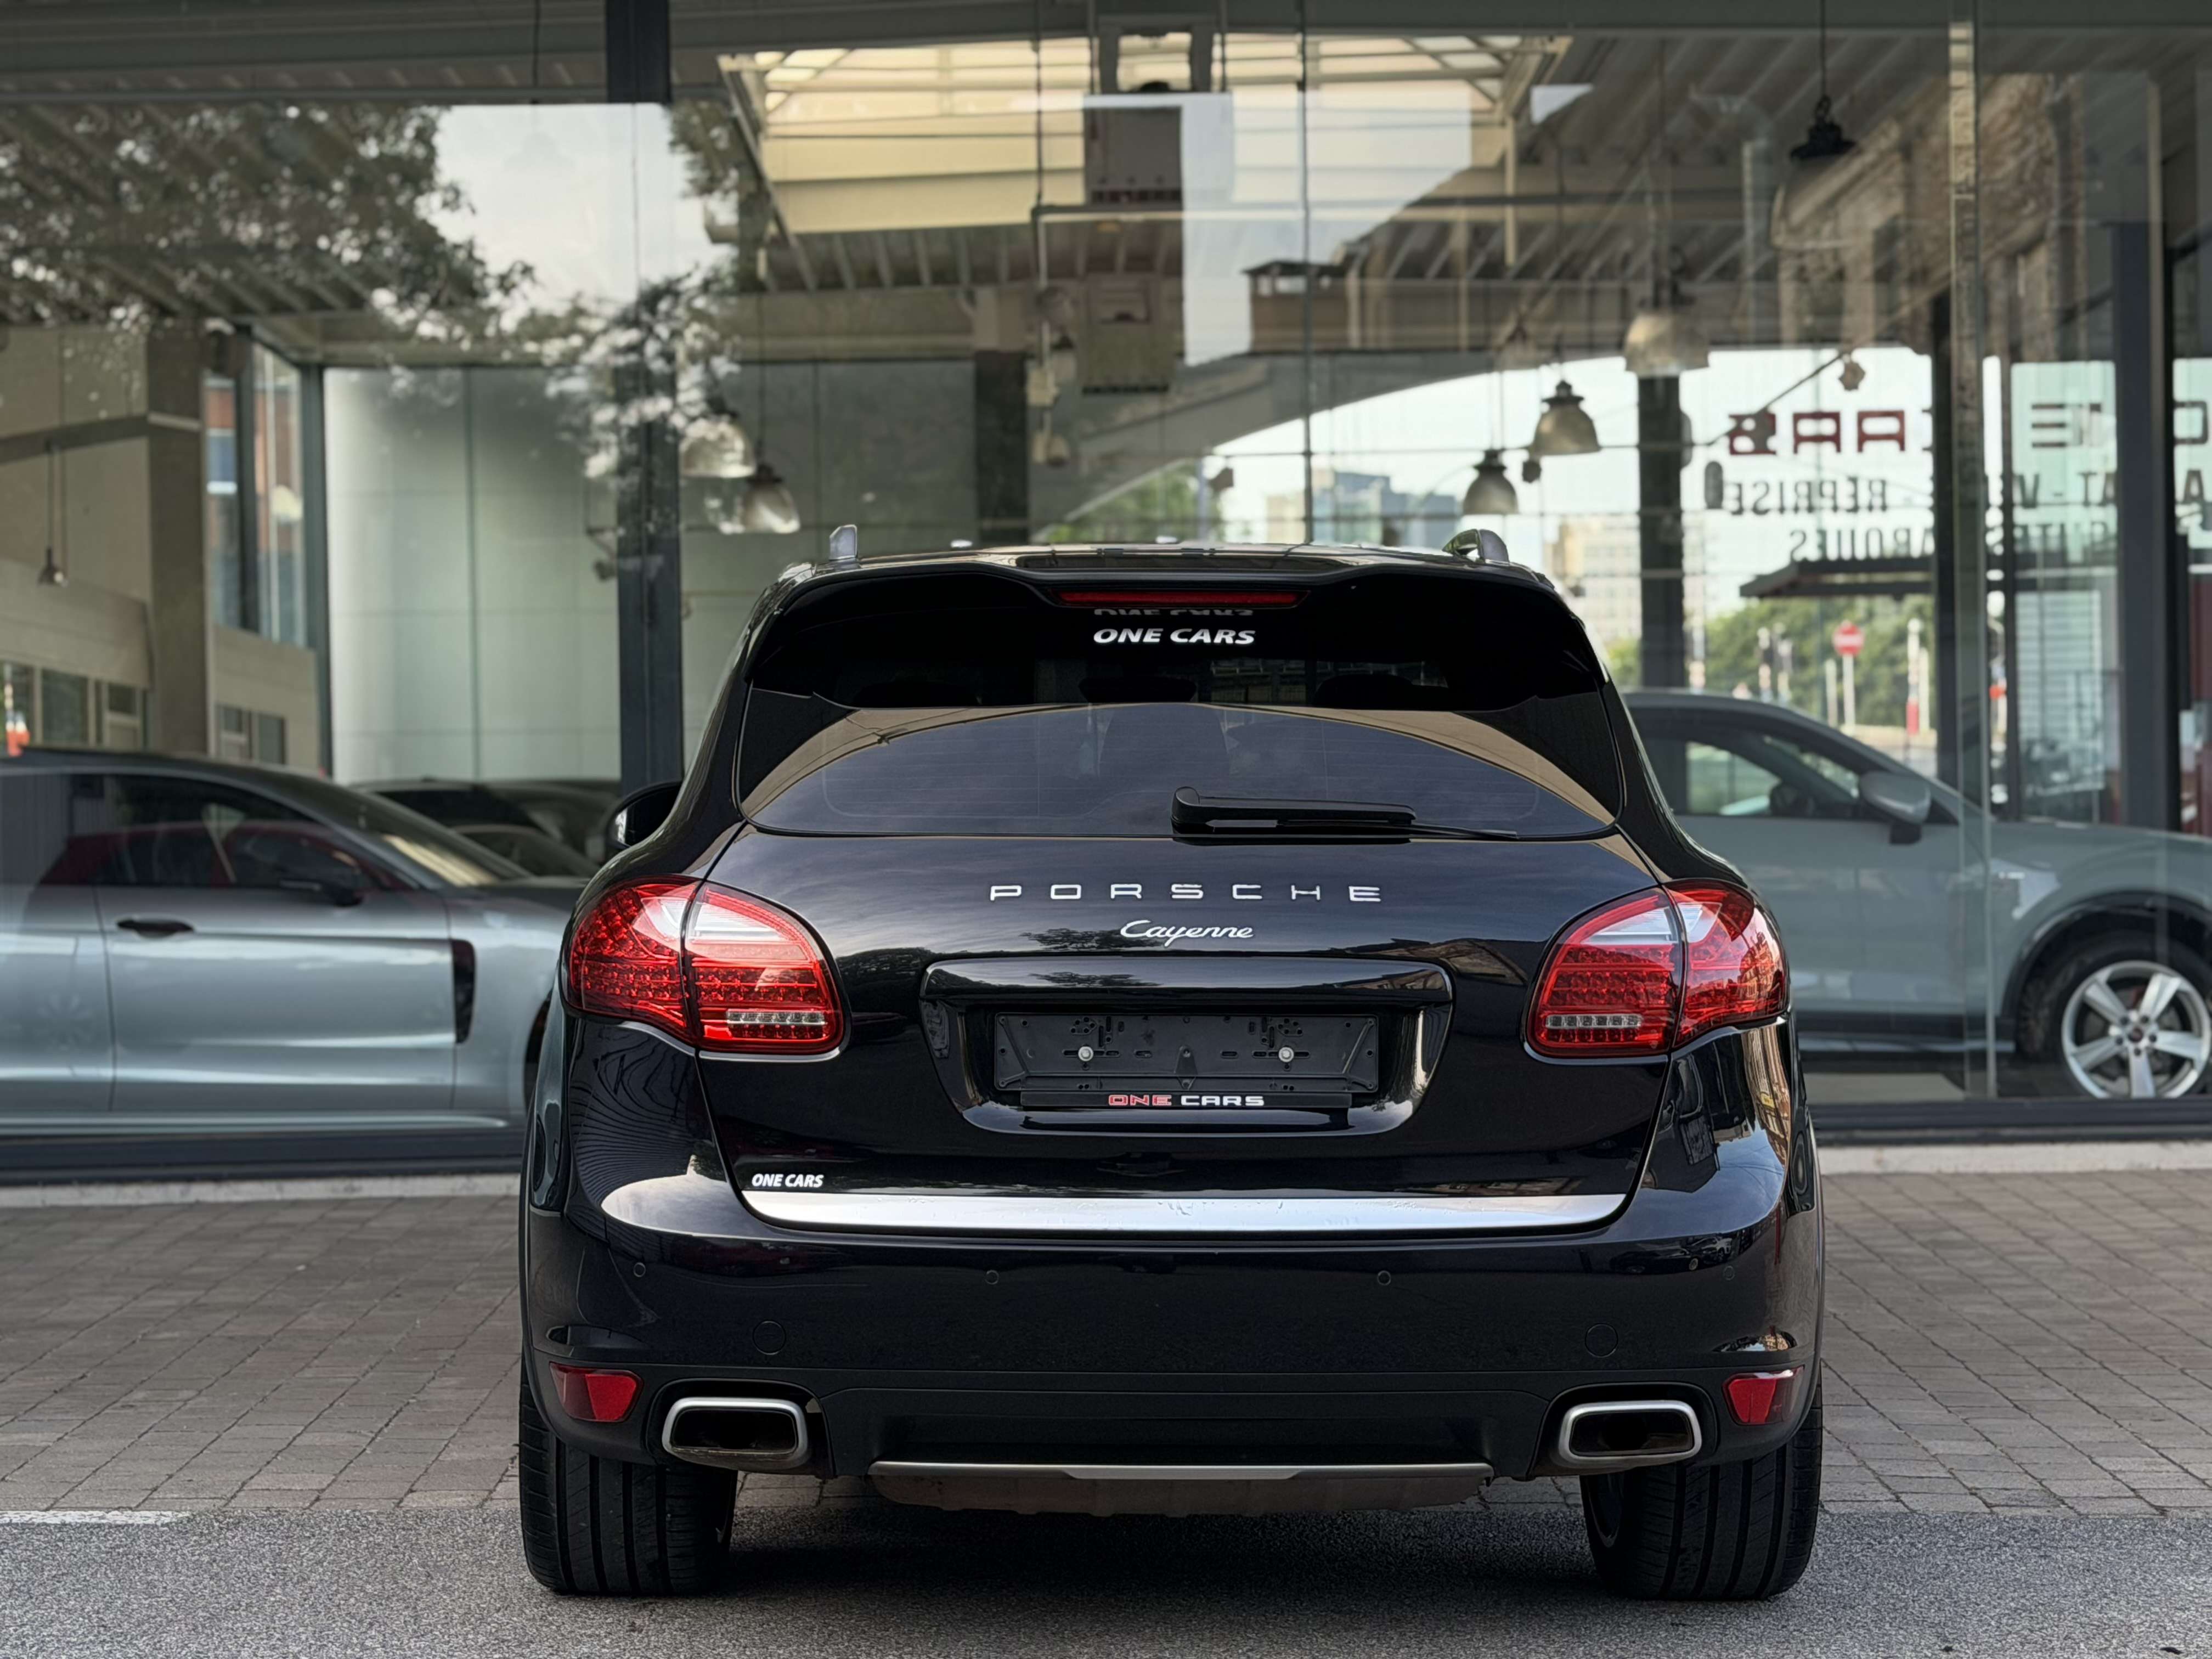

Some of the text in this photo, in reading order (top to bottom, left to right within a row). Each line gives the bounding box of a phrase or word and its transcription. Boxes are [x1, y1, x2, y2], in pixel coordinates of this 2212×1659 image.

[1093, 628, 1256, 645] ONE CARS
[990, 883, 1381, 902] PORSCHE
[1120, 919, 1254, 948] Cayenne
[1108, 1094, 1265, 1107] ONE CARS
[751, 1173, 825, 1188] ONE CARS
